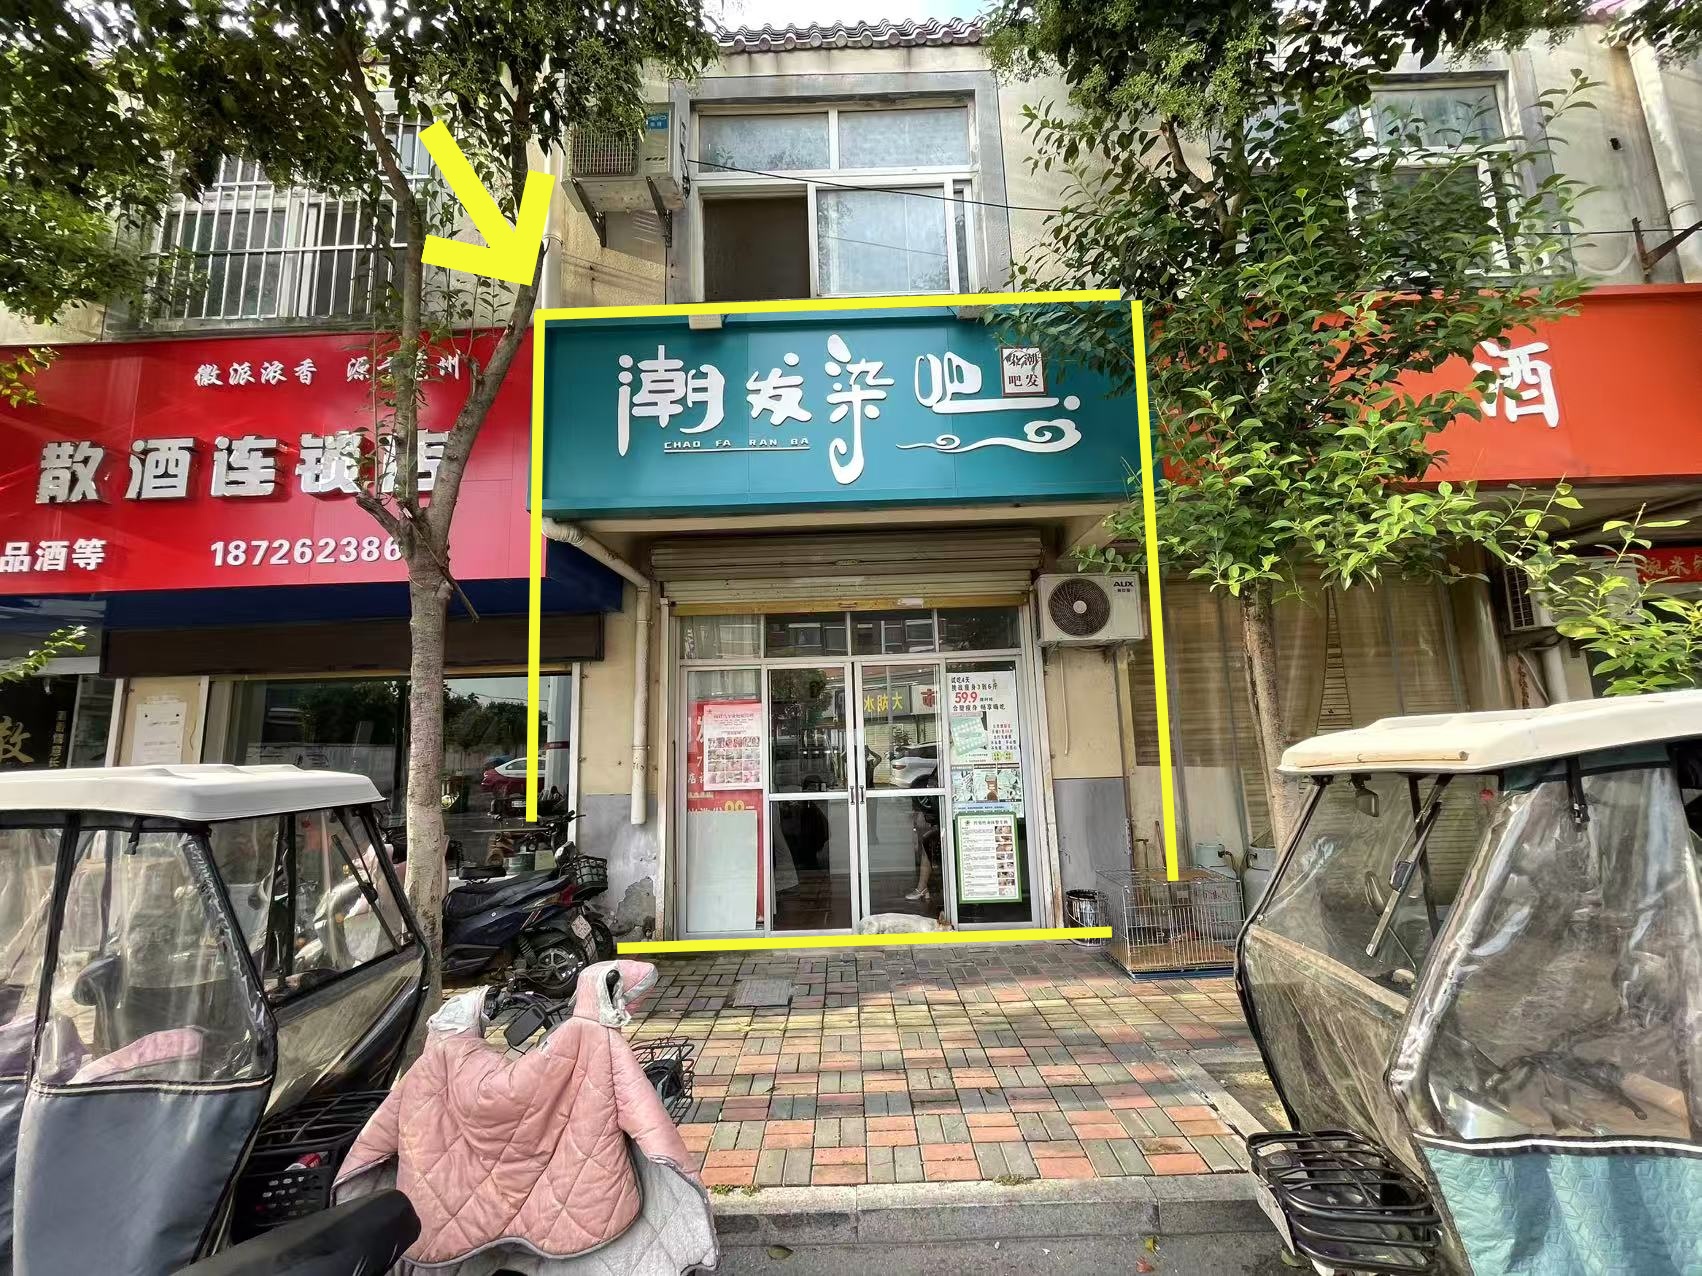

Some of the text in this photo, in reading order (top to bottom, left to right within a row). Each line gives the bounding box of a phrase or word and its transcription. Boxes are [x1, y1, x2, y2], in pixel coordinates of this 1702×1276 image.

[618, 334, 1060, 484] 潮发染吧
[1472, 340, 1560, 428] 酒
[35, 429, 451, 504] 散酒连锁店
[664, 437, 809, 449] CHAO FA RAN BA
[0, 538, 107, 572] 品酒等
[954, 691, 978, 704] 59.9
